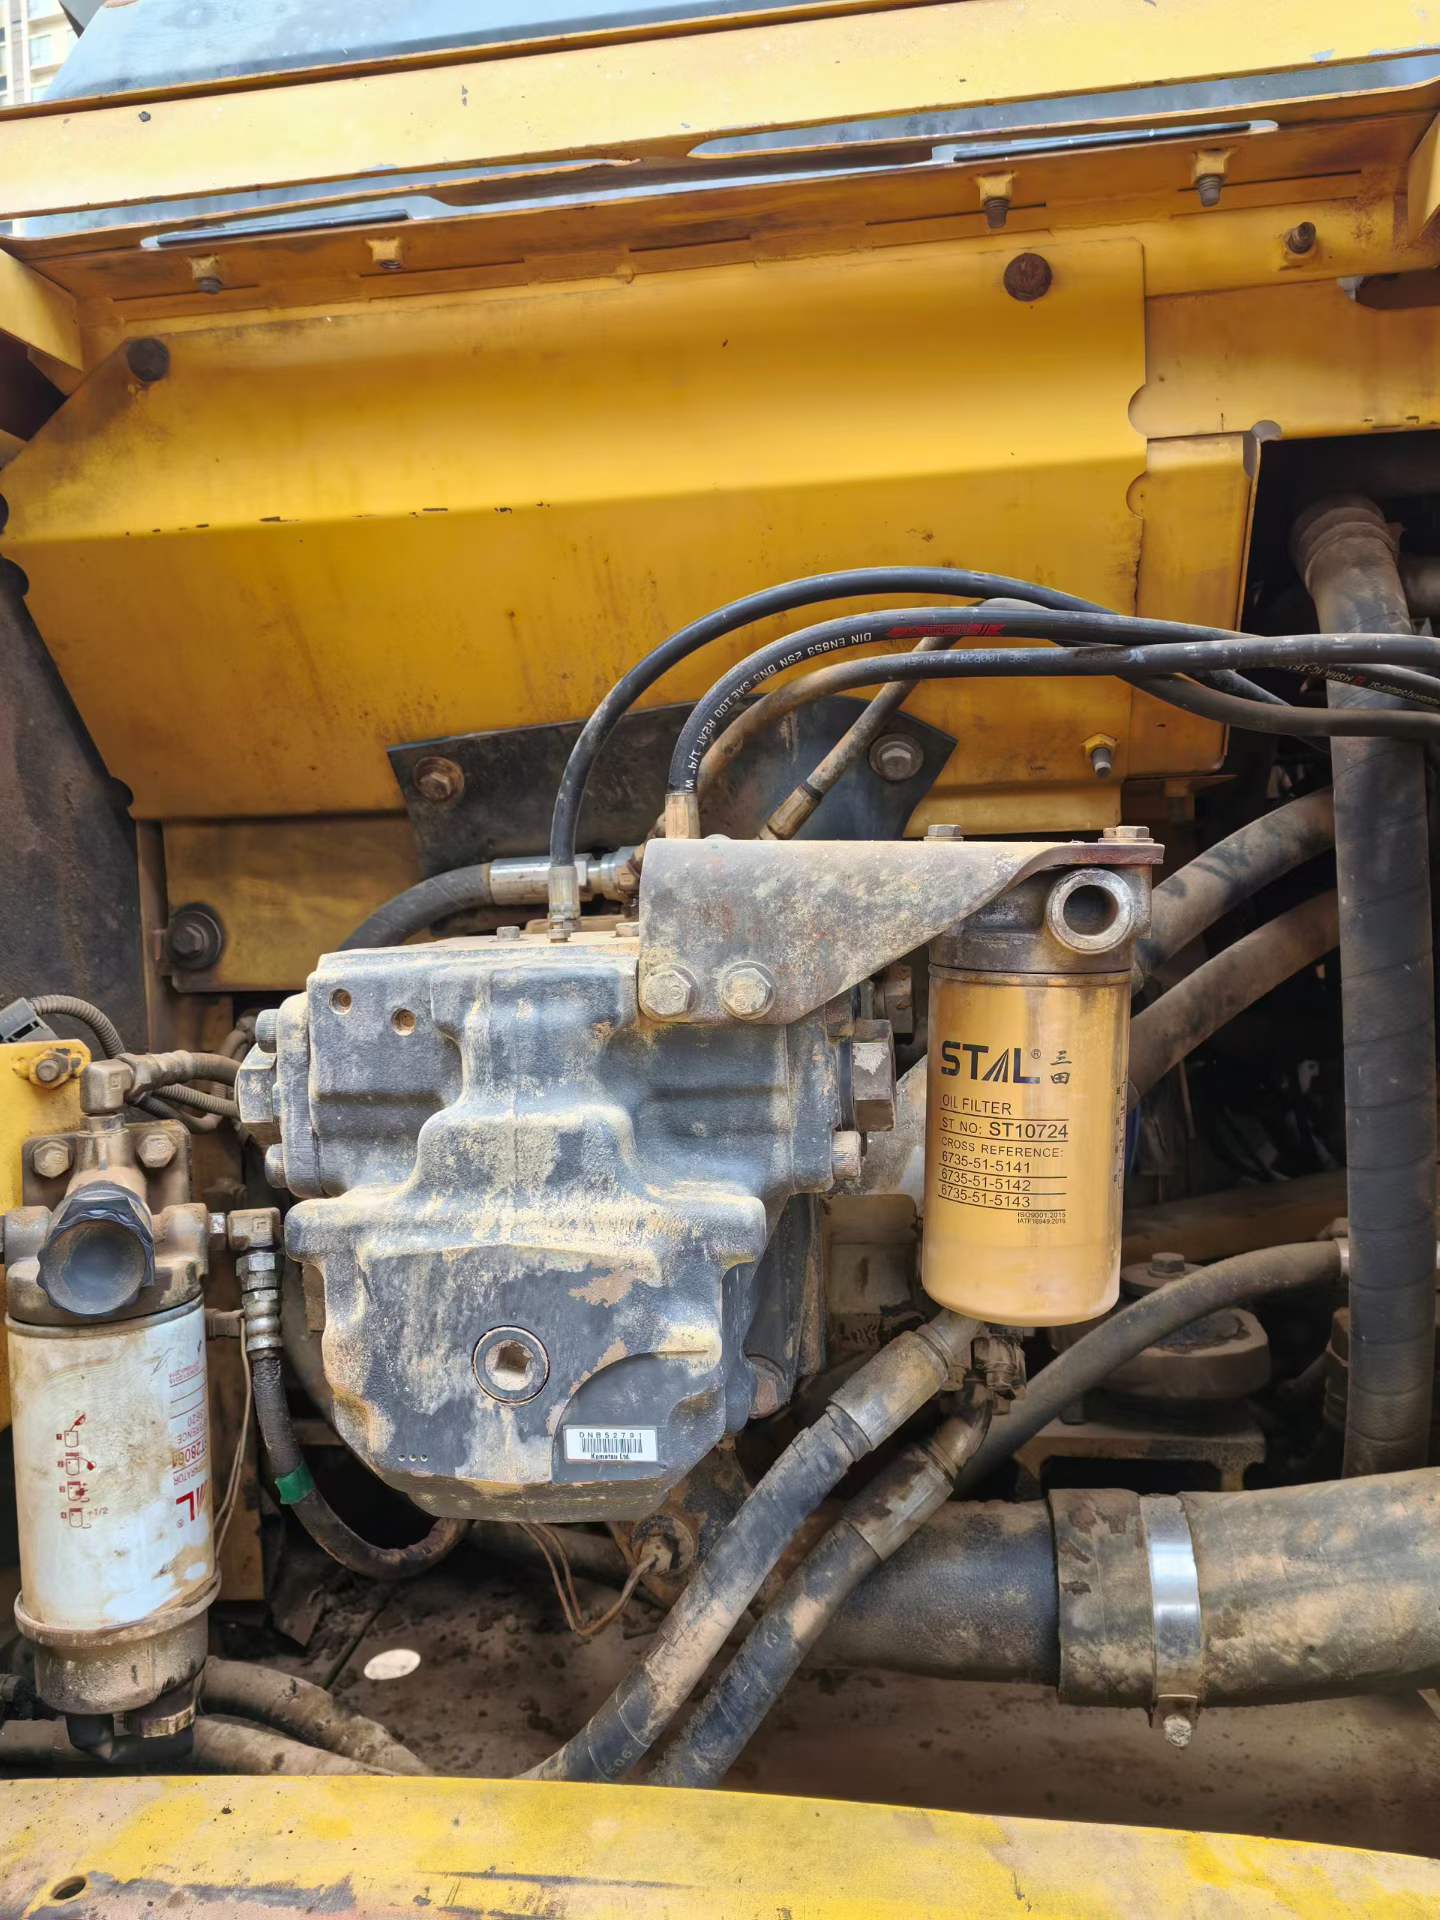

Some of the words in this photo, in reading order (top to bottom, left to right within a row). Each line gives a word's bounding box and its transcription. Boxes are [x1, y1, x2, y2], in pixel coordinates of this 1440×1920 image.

[807, 636, 847, 656] EN853
[850, 632, 872, 644] DIN
[779, 651, 802, 669] 2SN
[696, 718, 717, 747] R2AT
[942, 1094, 959, 1110] OIL
[962, 1098, 1012, 1116] FILTER
[941, 1116, 955, 1129] ST
[959, 1121, 982, 1135] NO:
[989, 1121, 1069, 1139] ST10724
[941, 1136, 976, 1152] CROSS
[981, 1144, 1064, 1158] REFERENCE:
[941, 1150, 1031, 1174] 6735-51-5141
[941, 1168, 1032, 1192] 6735-51-5142
[941, 1184, 1031, 1208] 6735-51-5143
